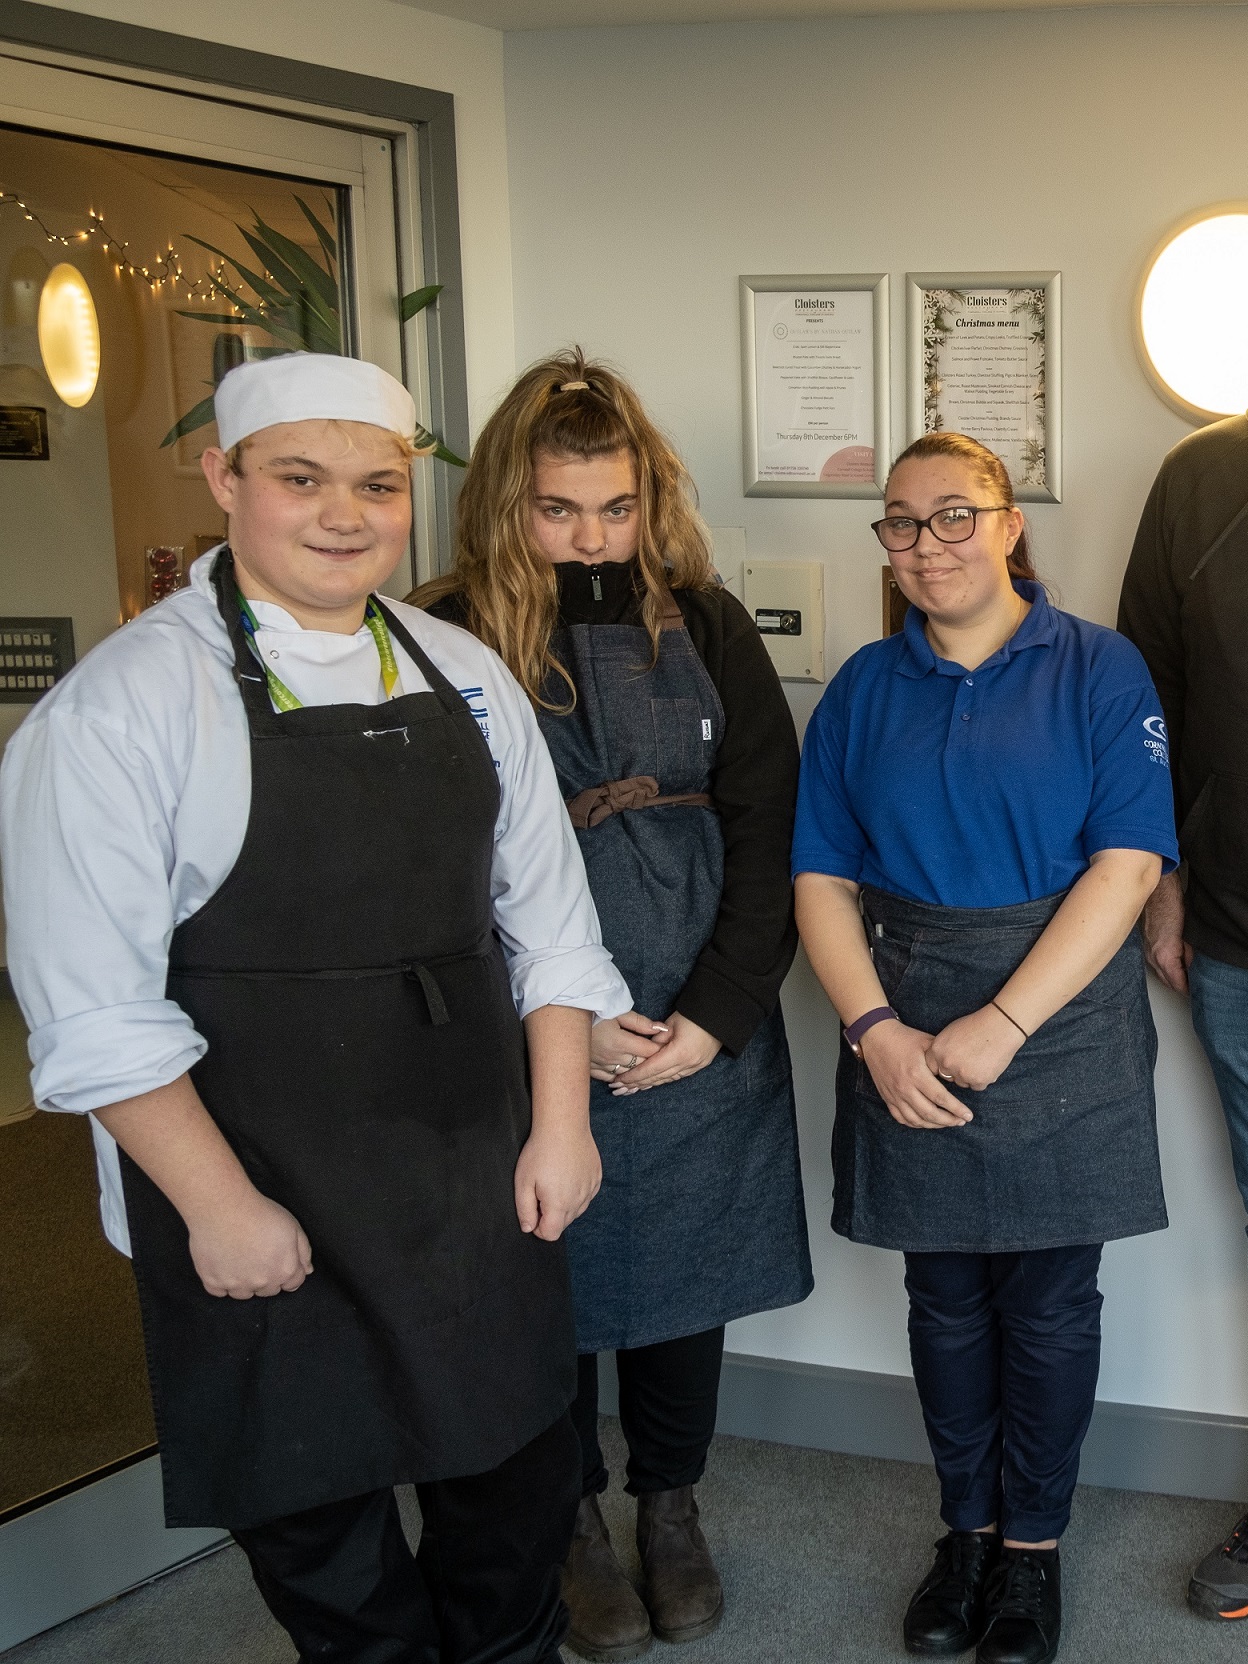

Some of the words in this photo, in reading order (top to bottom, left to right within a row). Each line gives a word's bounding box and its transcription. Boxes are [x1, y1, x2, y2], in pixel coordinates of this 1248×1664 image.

[794, 298, 835, 308] Cloisters
[967, 296, 1007, 306] Cloisters
[956, 318, 995, 328] Christmas
[776, 433, 802, 441] Thursday
